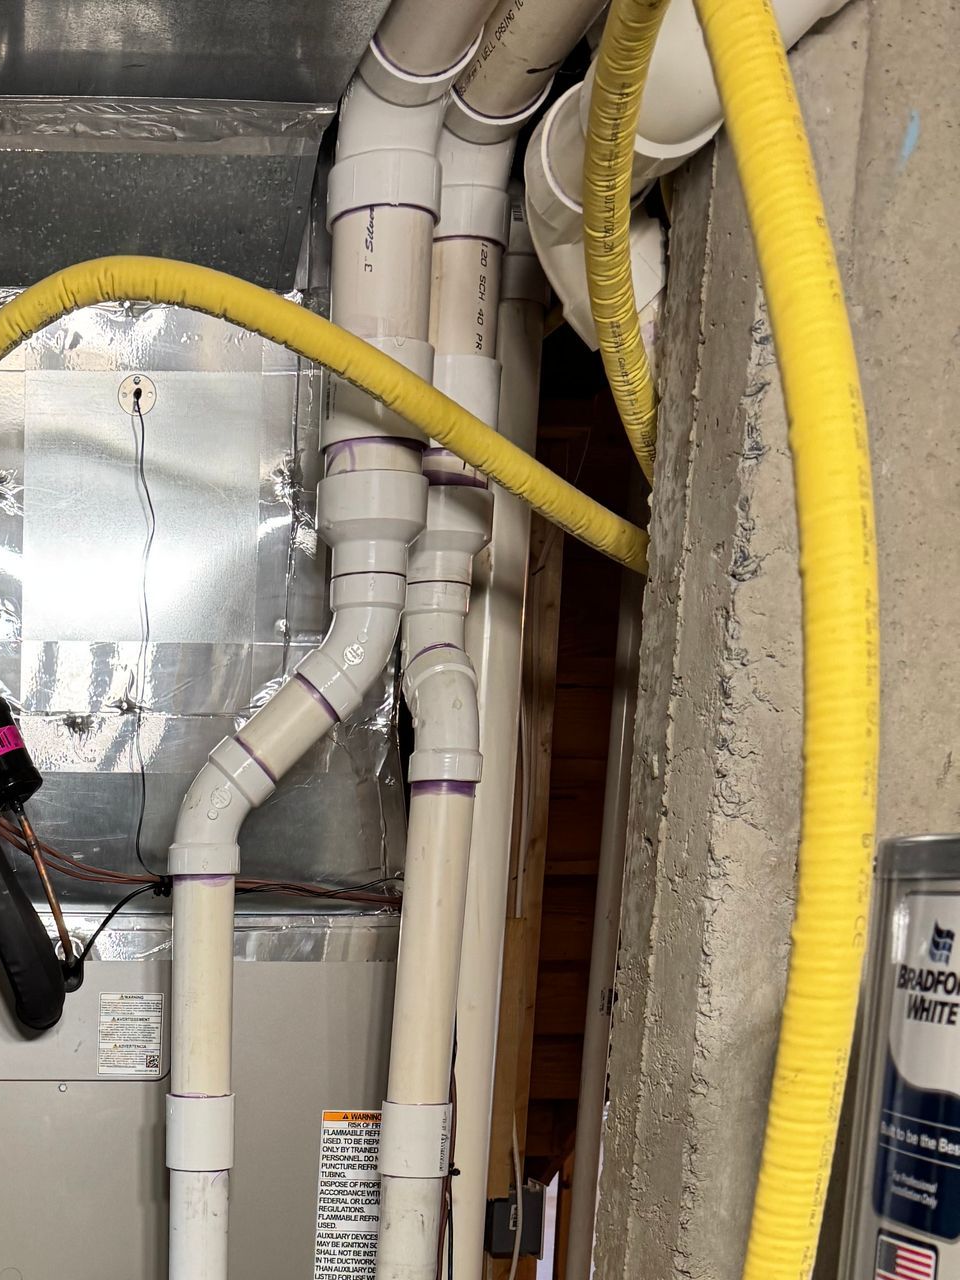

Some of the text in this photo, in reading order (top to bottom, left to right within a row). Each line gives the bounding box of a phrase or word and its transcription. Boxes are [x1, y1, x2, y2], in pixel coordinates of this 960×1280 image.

[495, 10, 515, 41] CASING
[478, 274, 487, 302] SCH
[476, 308, 484, 326] 40
[475, 333, 483, 351] PR
[897, 965, 960, 996] BRADFO
[906, 994, 959, 1026] WHITE
[323, 1129, 363, 1137] FLAMMABLE
[905, 1130, 918, 1145] be
[920, 1133, 937, 1150] the
[319, 1189, 365, 1197] ACCORDANCE
[319, 1197, 349, 1205] FEDERAL
[316, 1232, 351, 1240] AUXILIARY
[341, 1241, 369, 1249] IGNITION
[333, 1265, 367, 1273] AUXILIARY
